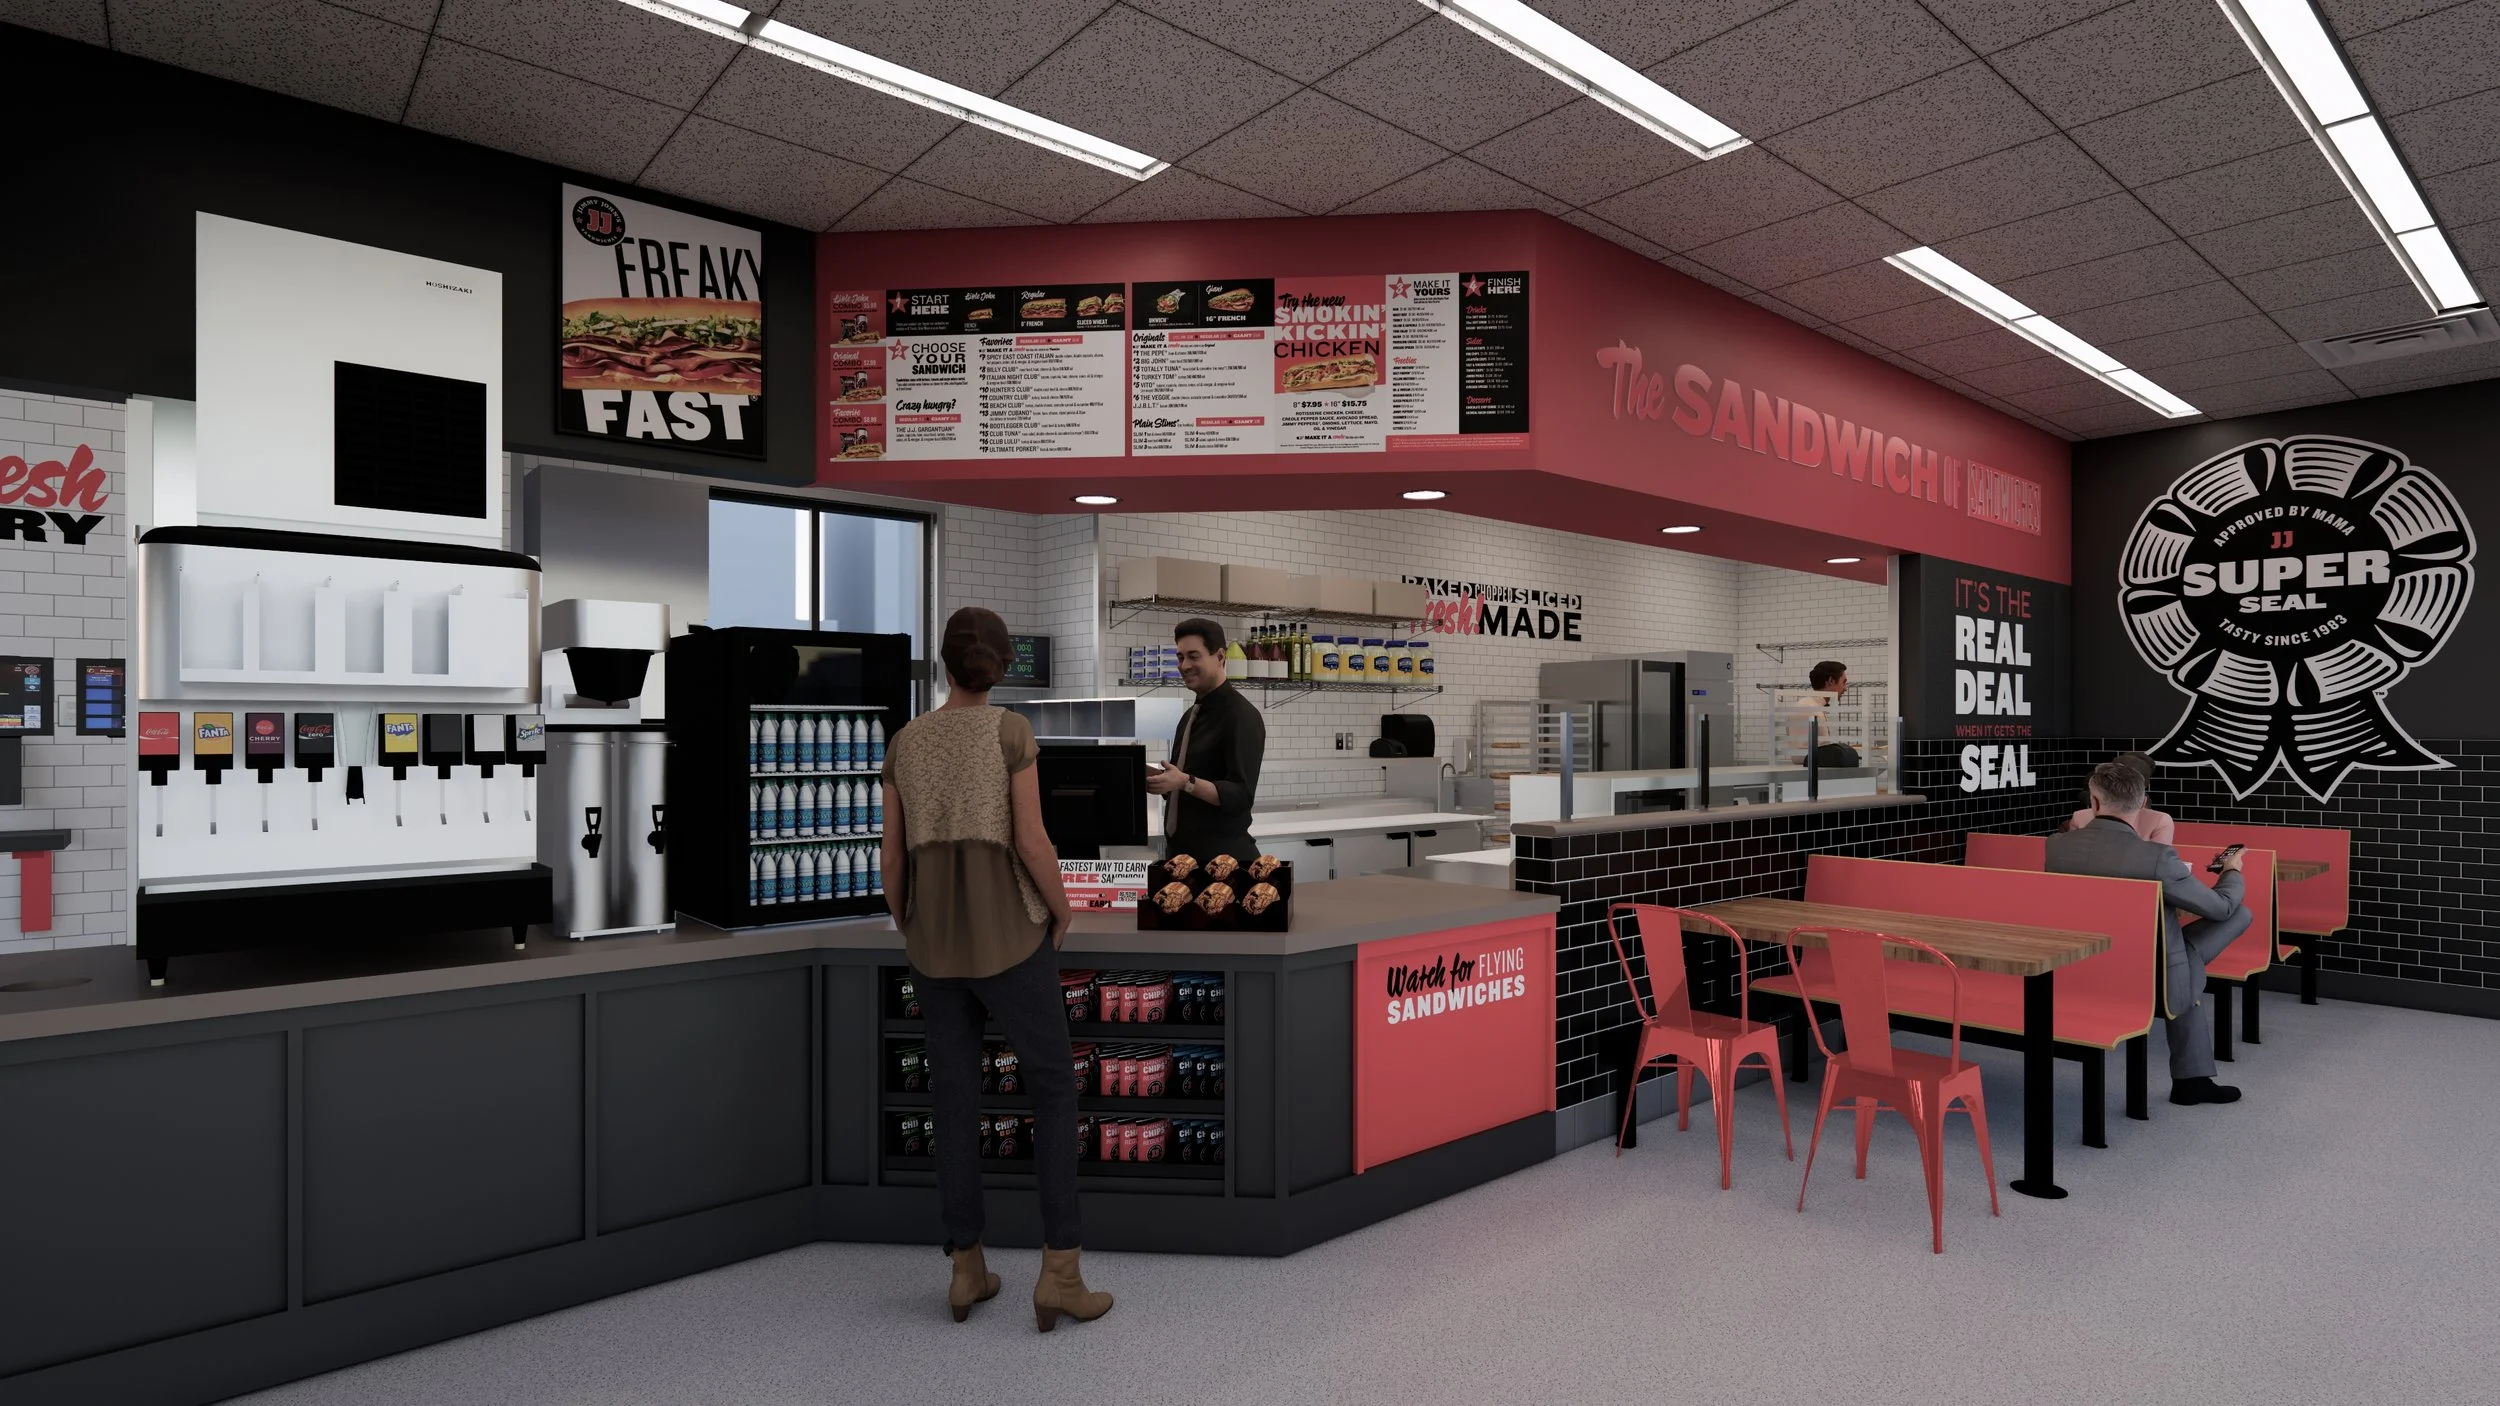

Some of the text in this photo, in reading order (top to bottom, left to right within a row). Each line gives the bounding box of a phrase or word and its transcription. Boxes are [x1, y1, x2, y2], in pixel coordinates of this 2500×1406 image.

[576, 199, 598, 214] JIMMY
[587, 208, 613, 235] JJ
[614, 236, 762, 301] FREAKY
[425, 280, 473, 295] HOSHIZAKI
[1414, 280, 1450, 288] MAKE IT
[1488, 278, 1521, 286] FINISH
[1021, 291, 1046, 300] Regular
[1206, 285, 1223, 295] Giant
[1414, 288, 1451, 297] YOURS
[1488, 286, 1520, 294] HERE
[912, 295, 950, 305] START
[1278, 293, 1345, 312] Try the new
[912, 305, 950, 315] HERE
[1275, 305, 1386, 324] SMOKIN'
[1465, 306, 1487, 314] Drinks
[1275, 323, 1386, 340] KICKIN'
[980, 337, 1013, 347] Favorites
[1134, 332, 1165, 344] Originals
[1466, 337, 1483, 345] Sides
[912, 343, 966, 353] CHOOSE
[1274, 341, 1379, 358] CHICKEN
[913, 354, 965, 363] YOUR
[912, 364, 966, 375] SANDWICH
[896, 399, 956, 412] Crazy hungry?
[1466, 396, 1492, 404] Desserts
[582, 389, 750, 441] FAST
[1133, 418, 1178, 428] Plain Slims
[1597, 339, 1666, 421] The
[1673, 364, 1938, 504] SANDWICH
[1943, 456, 1961, 509] OF
[1970, 462, 2041, 535] SANDWICHES
[2213, 505, 2356, 547] APPROVED BY MAMA
[2271, 531, 2293, 548] JJ
[2183, 550, 2391, 597] SUPER
[1475, 583, 1513, 602] CHOPPED
[1515, 588, 1580, 610] SLICED
[1956, 578, 2031, 618] IT'S THE
[2239, 593, 2327, 614] SEAL
[1479, 604, 1581, 642] MADE
[2218, 614, 2348, 647] TASTY SINCE 1983
[1956, 615, 2031, 666] REAL
[1956, 669, 2031, 716] DEAL
[199, 728, 229, 738] FANTA
[387, 724, 414, 733] FANTA
[520, 728, 541, 738] Sprite
[1956, 725, 2031, 737] WHEN IT GETS THE
[1960, 744, 2036, 793] SEAL
[1060, 862, 1146, 872] FASTEST WAY TO EARN
[1062, 873, 1100, 883] REE
[1387, 947, 1524, 998] Watch for FLYING
[1066, 989, 1089, 999] CHIPS
[1143, 989, 1165, 1000] CHIPS
[1388, 975, 1525, 1025] SANDWICHES
[1143, 1063, 1165, 1074] CHIPS
[1143, 1127, 1165, 1138] CHIPS
